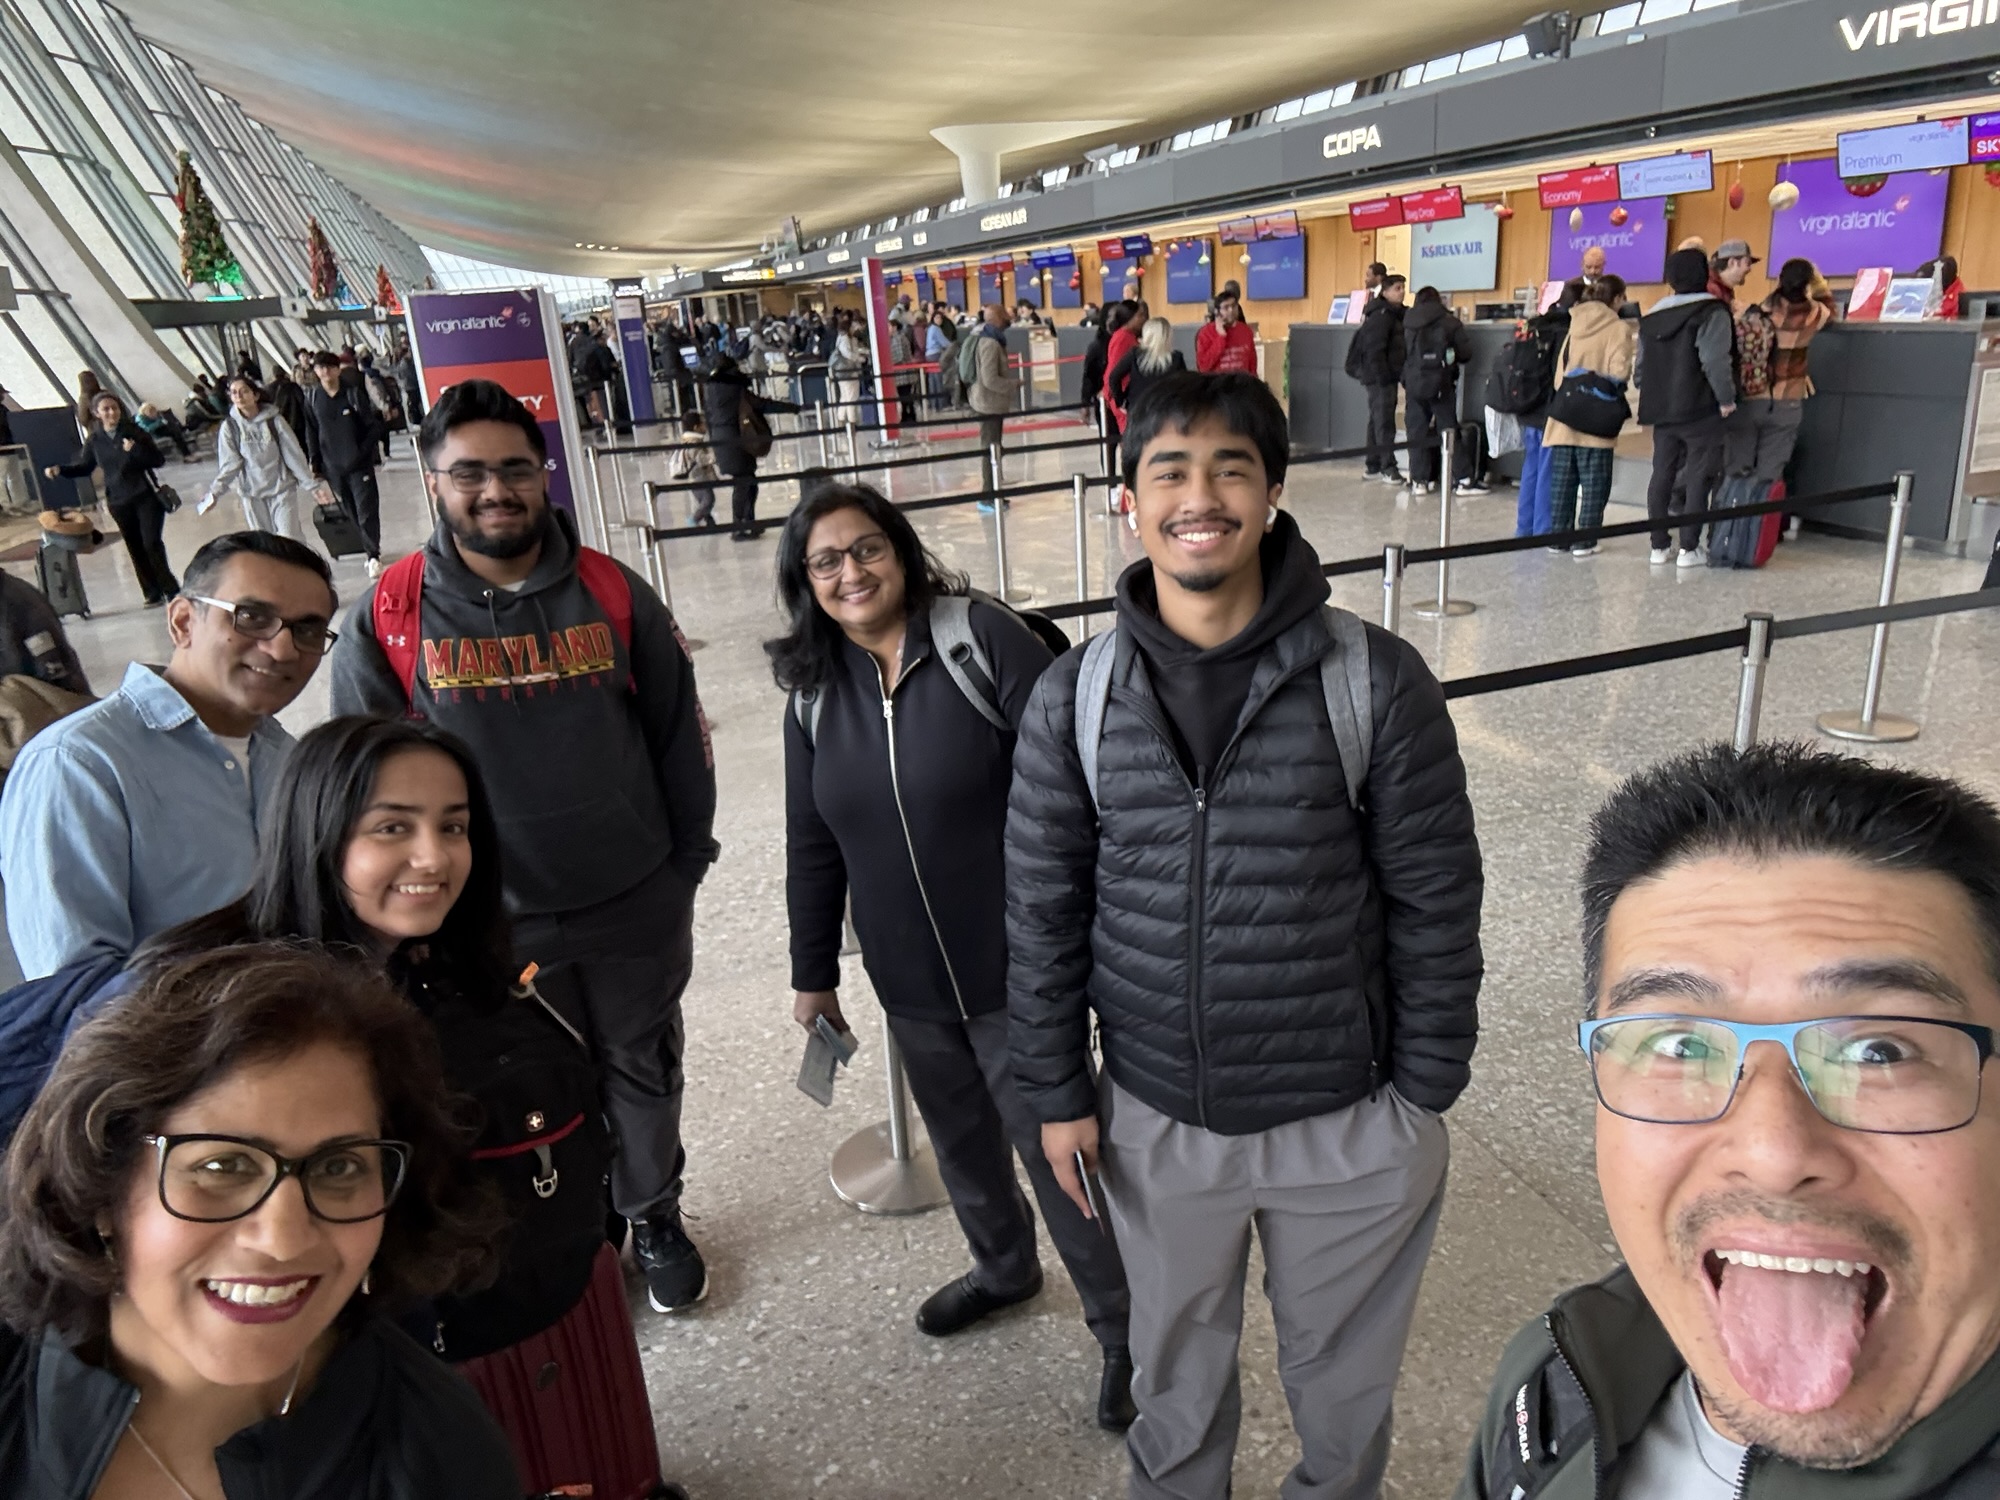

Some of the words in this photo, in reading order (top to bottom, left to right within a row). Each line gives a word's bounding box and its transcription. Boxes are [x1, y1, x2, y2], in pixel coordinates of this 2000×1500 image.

[1323, 124, 1382, 159] COPA
[1977, 138, 2000, 153] SK
[1844, 153, 1903, 169] Premium
[1543, 190, 1583, 203] Economy
[1799, 214, 1840, 236] virgin
[1841, 208, 1896, 231] atlantic
[1462, 241, 1483, 255] AIR
[425, 318, 461, 335] virgin
[461, 315, 506, 331] atlantic
[423, 622, 615, 679] MARYLAND
